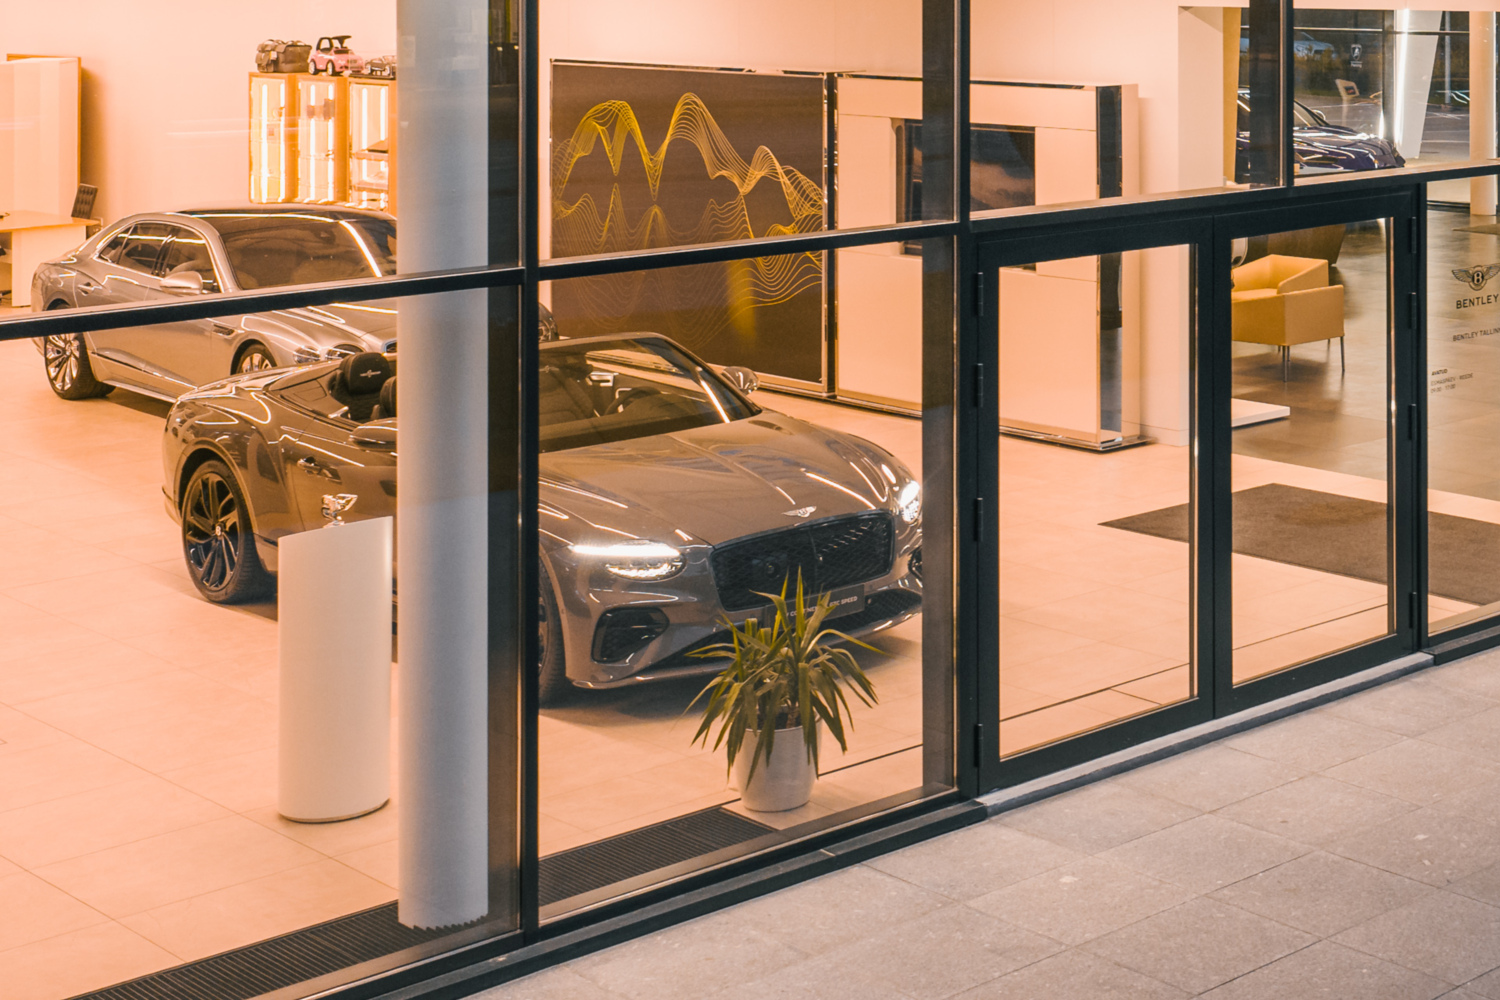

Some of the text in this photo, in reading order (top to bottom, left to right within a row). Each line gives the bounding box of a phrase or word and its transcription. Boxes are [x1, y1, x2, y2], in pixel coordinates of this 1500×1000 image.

[1456, 294, 1499, 309] BENTLEY
[1453, 331, 1478, 342] BENTLEY
[841, 596, 858, 605] SPEED
